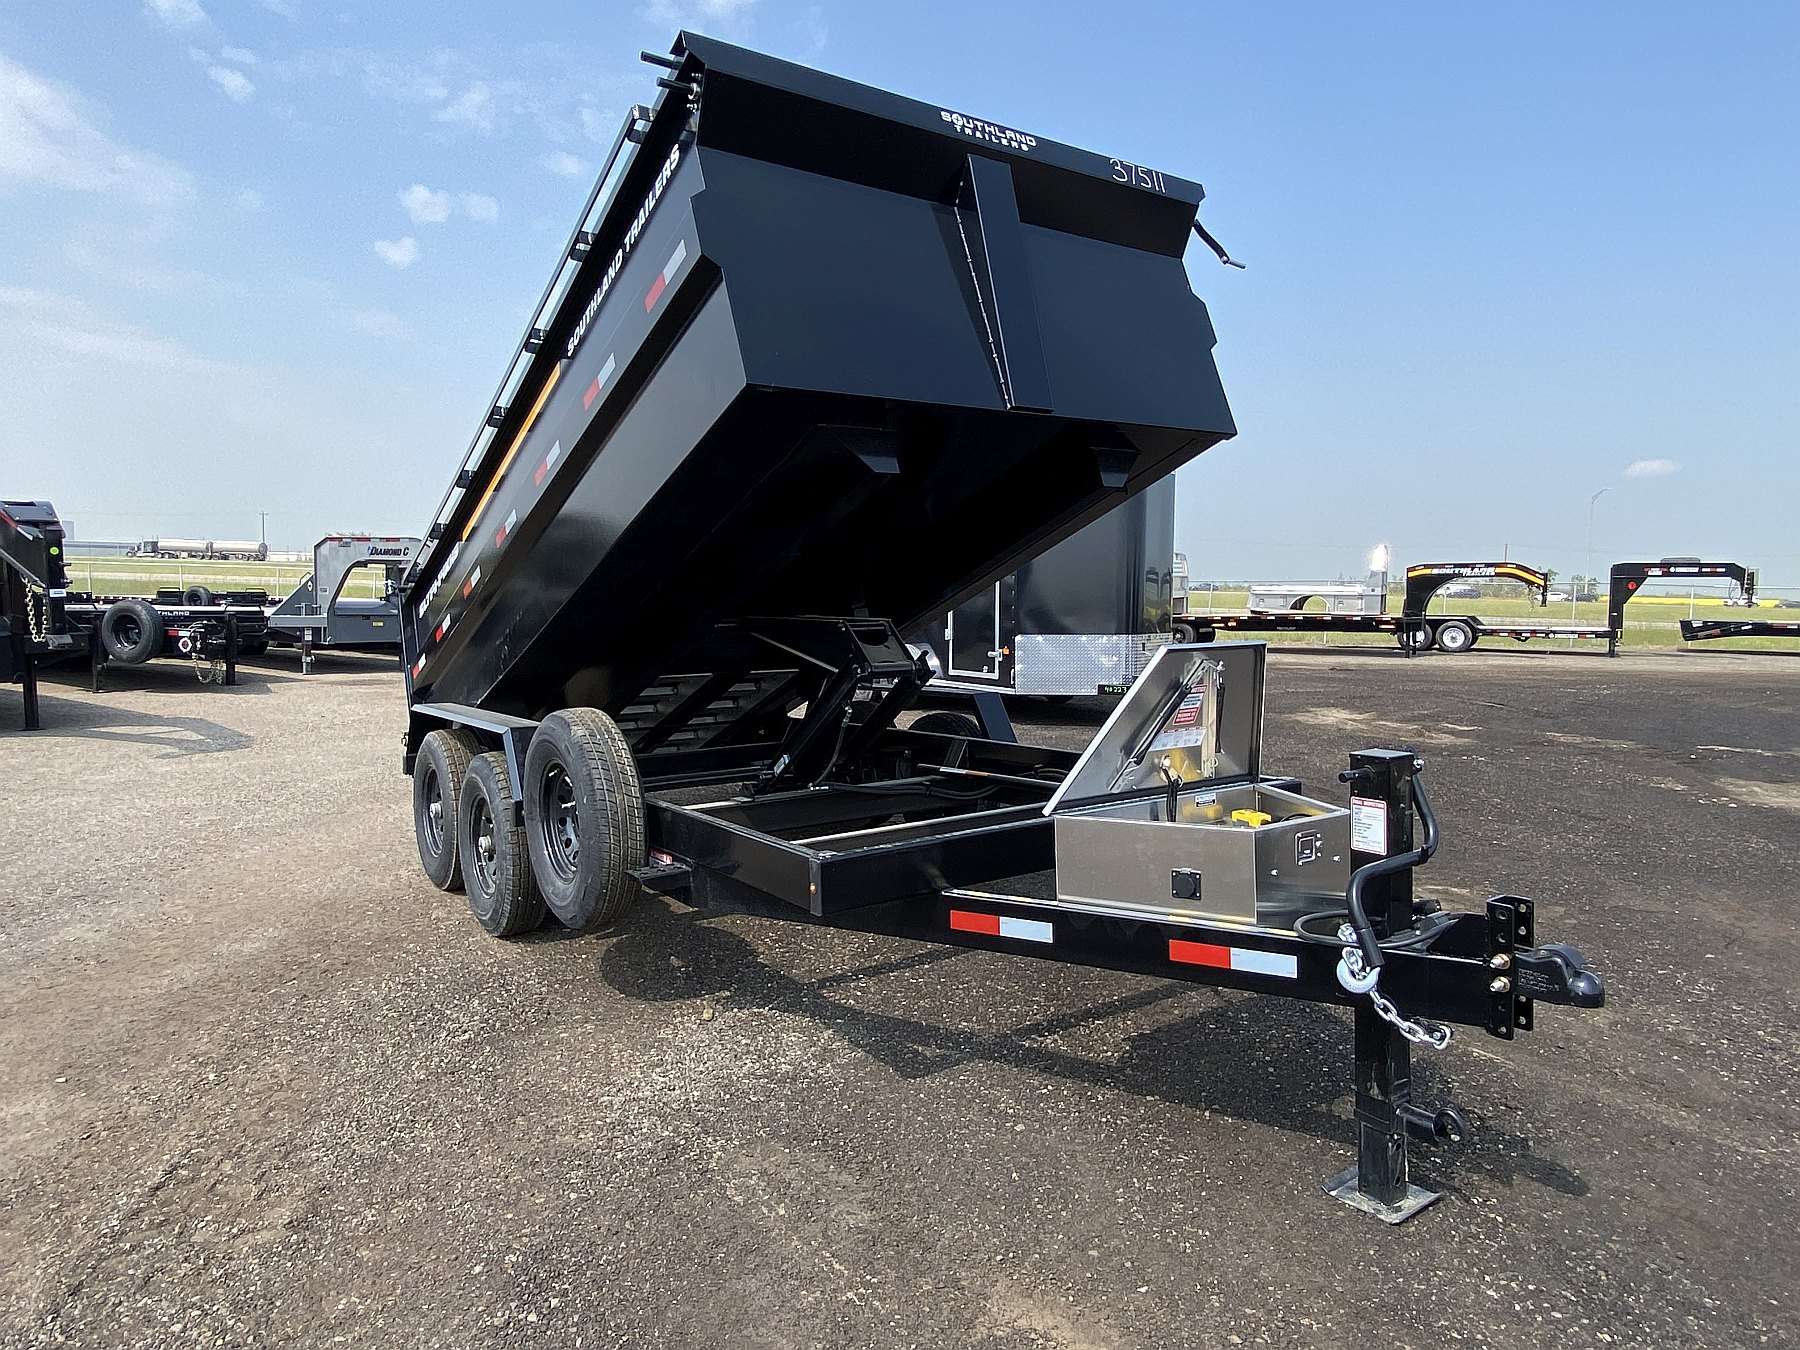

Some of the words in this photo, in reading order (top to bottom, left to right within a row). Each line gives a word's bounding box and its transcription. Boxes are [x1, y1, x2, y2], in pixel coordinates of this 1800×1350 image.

[940, 111, 1037, 147] SOUTHLAND
[954, 125, 1029, 151] TRAILERS
[1110, 158, 1166, 193] 37511
[567, 248, 623, 357] SOUTHLAND
[624, 143, 681, 253] TRAILERS
[369, 546, 402, 556] DIAMOND
[402, 546, 410, 556] C
